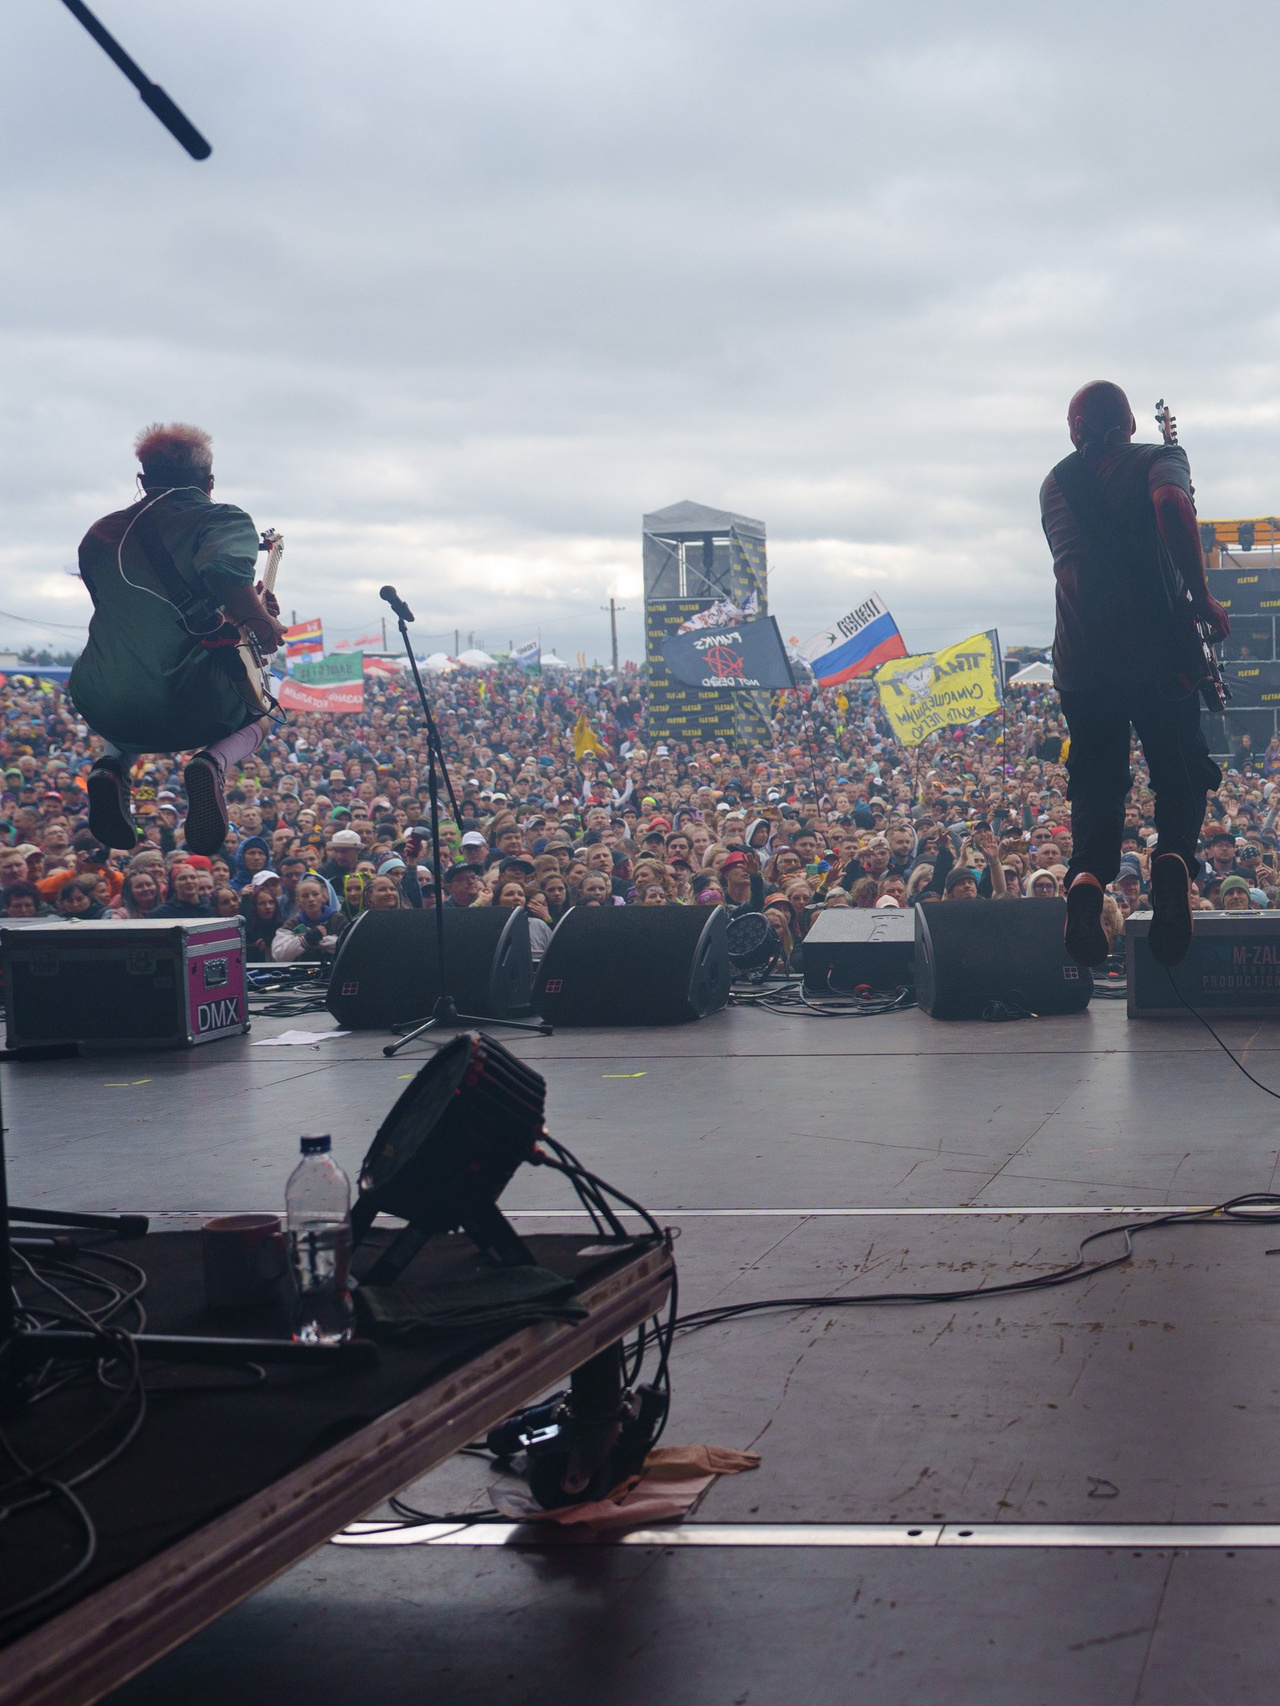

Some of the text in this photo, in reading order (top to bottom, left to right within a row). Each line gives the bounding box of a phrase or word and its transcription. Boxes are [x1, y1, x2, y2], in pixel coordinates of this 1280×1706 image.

[1232, 945, 1280, 965] M-ZAL
[1233, 966, 1280, 974] STUDIO
[197, 997, 239, 1031] DMX
